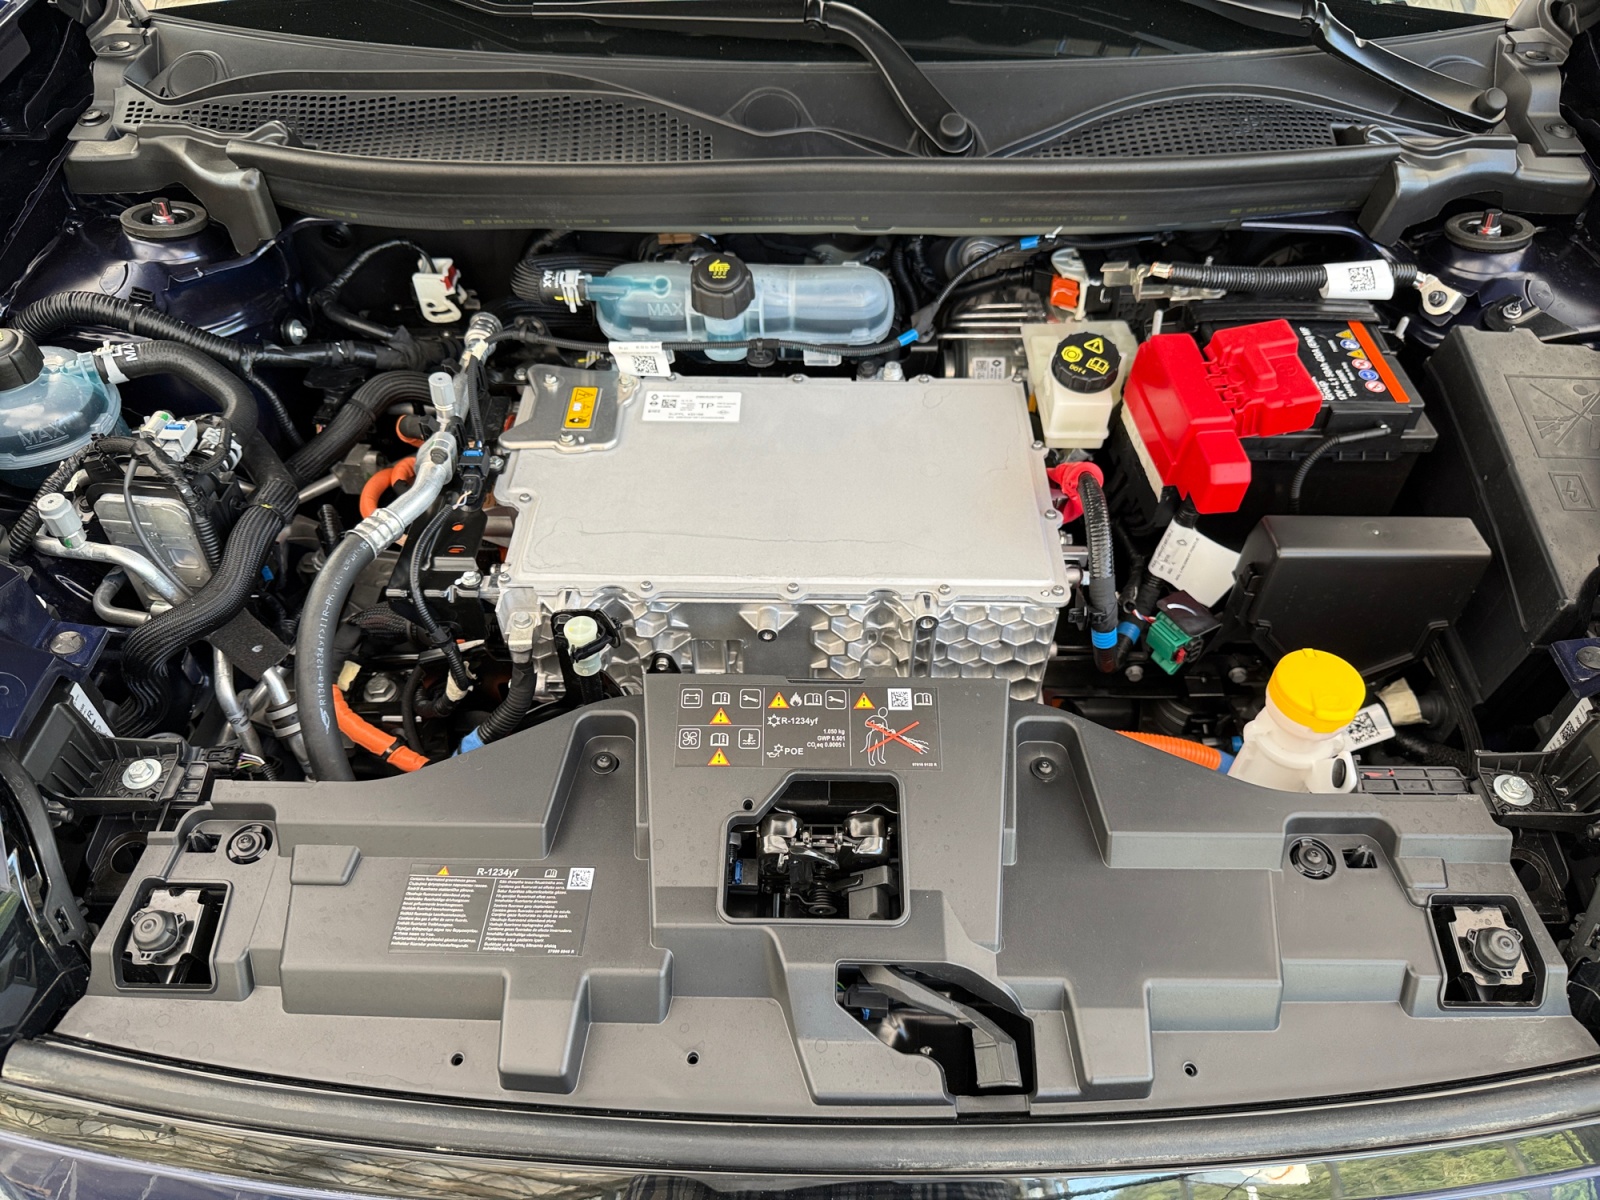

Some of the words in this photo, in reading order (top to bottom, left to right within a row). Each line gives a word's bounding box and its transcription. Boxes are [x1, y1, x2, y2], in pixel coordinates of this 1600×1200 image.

[647, 303, 684, 317] MAX
[17, 420, 66, 447] MAX
[781, 716, 818, 726] R-1234yf
[784, 748, 804, 756] POE
[476, 868, 520, 878] R-1234yf
